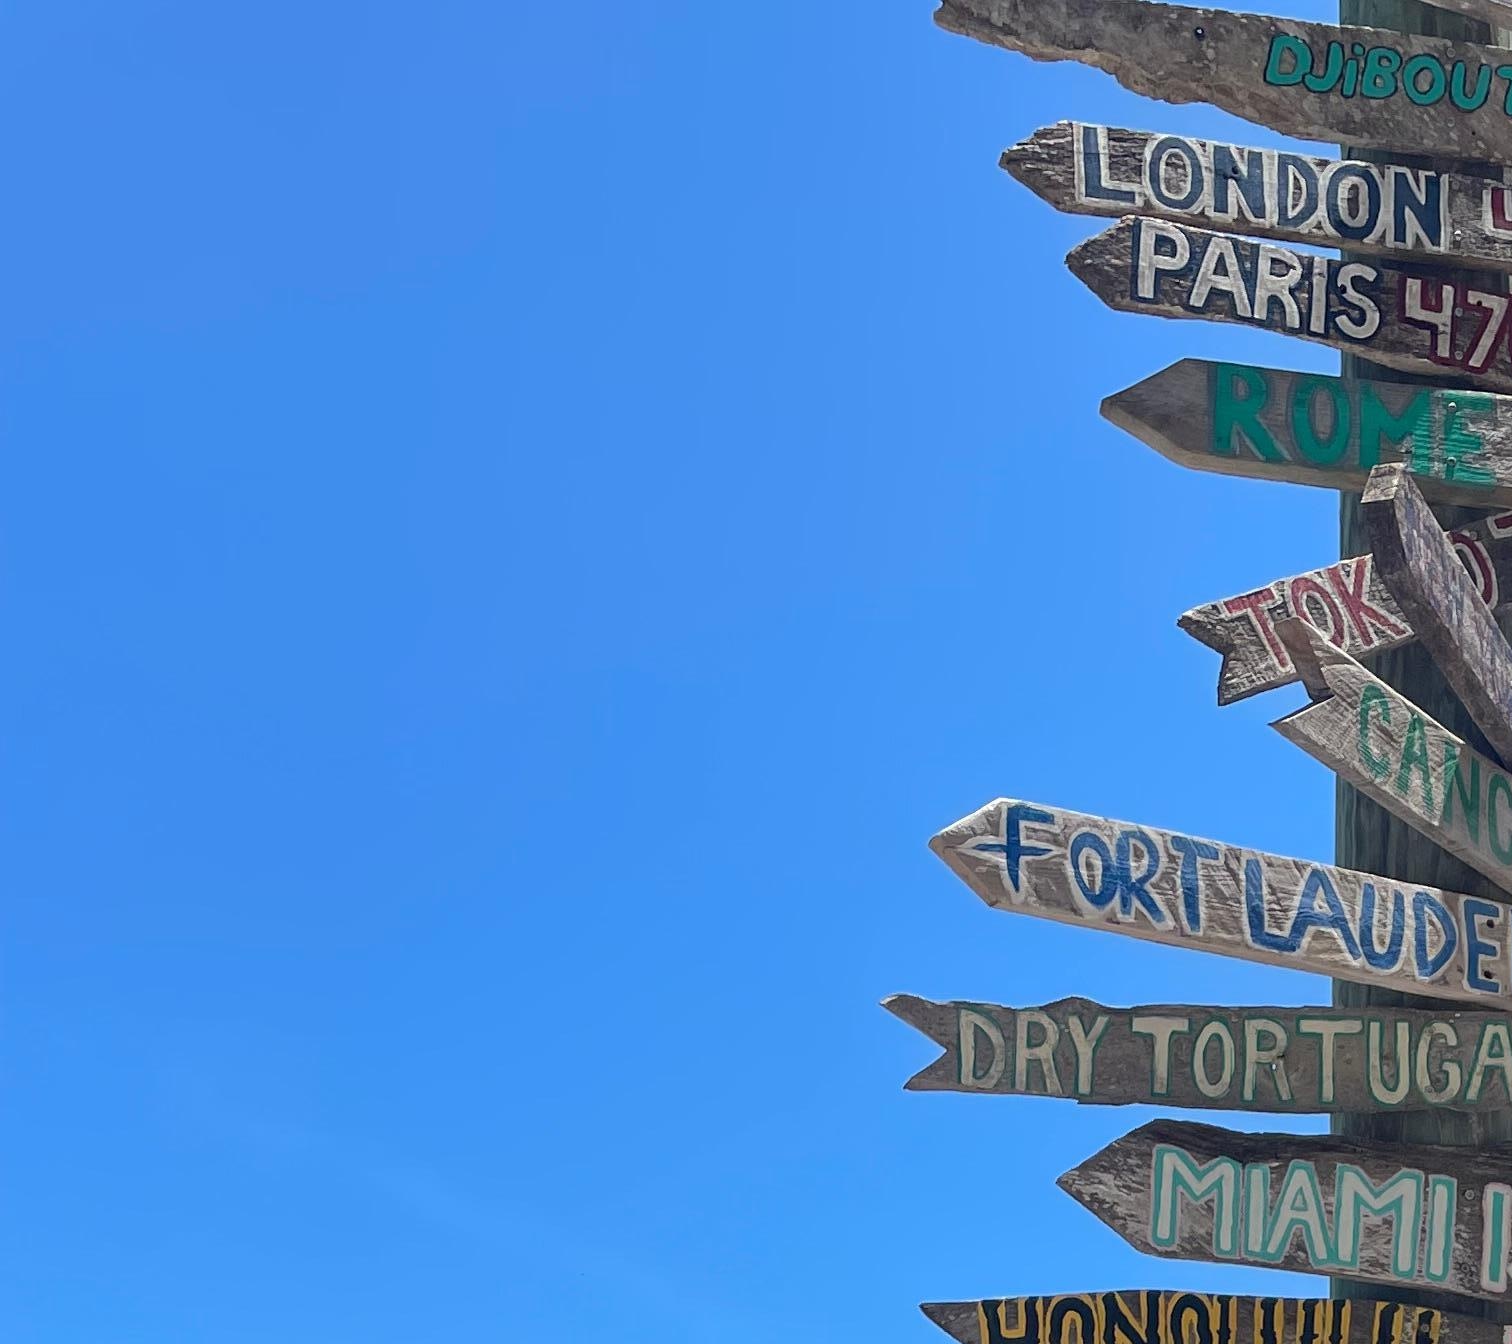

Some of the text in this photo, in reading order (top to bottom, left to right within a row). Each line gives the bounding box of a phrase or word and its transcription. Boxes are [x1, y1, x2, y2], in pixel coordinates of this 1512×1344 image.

[1072, 120, 1448, 254] LONDON
[1131, 216, 1381, 341] PARIS
[1208, 362, 1500, 489] ROME
[970, 802, 1222, 936] FORT
[957, 1005, 1110, 1096] DRY
[1150, 1143, 1457, 1282] MIAMI
